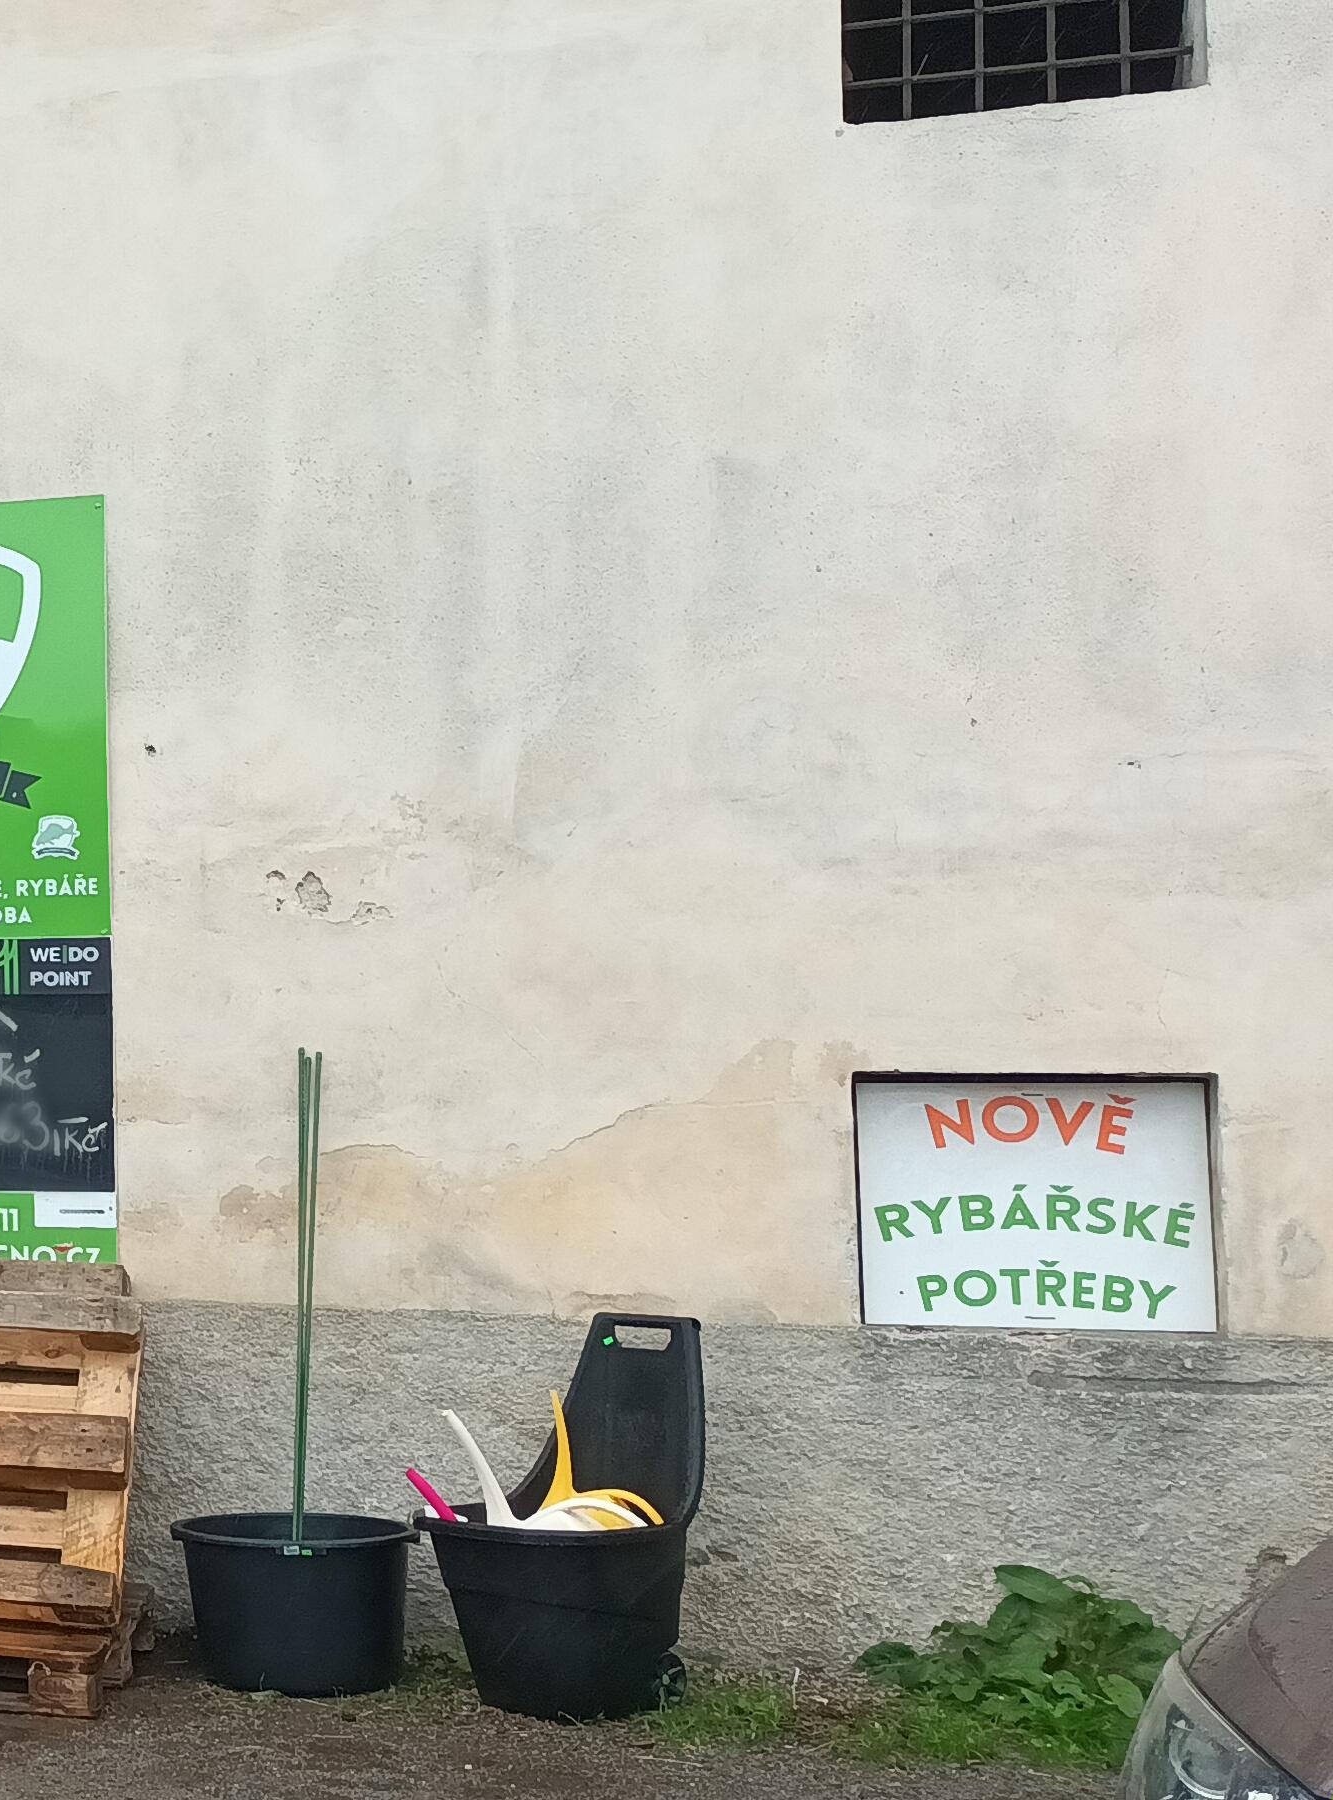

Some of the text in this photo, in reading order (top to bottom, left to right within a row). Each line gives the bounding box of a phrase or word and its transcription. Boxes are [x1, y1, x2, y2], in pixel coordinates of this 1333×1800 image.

[16, 874, 99, 897] RYBÁŘE
[29, 970, 93, 987] POINT
[924, 1093, 1137, 1155] NOVĚ
[874, 1183, 1196, 1249] RYBÁŘSKÉ
[916, 1259, 1178, 1320] POTŘEBY
